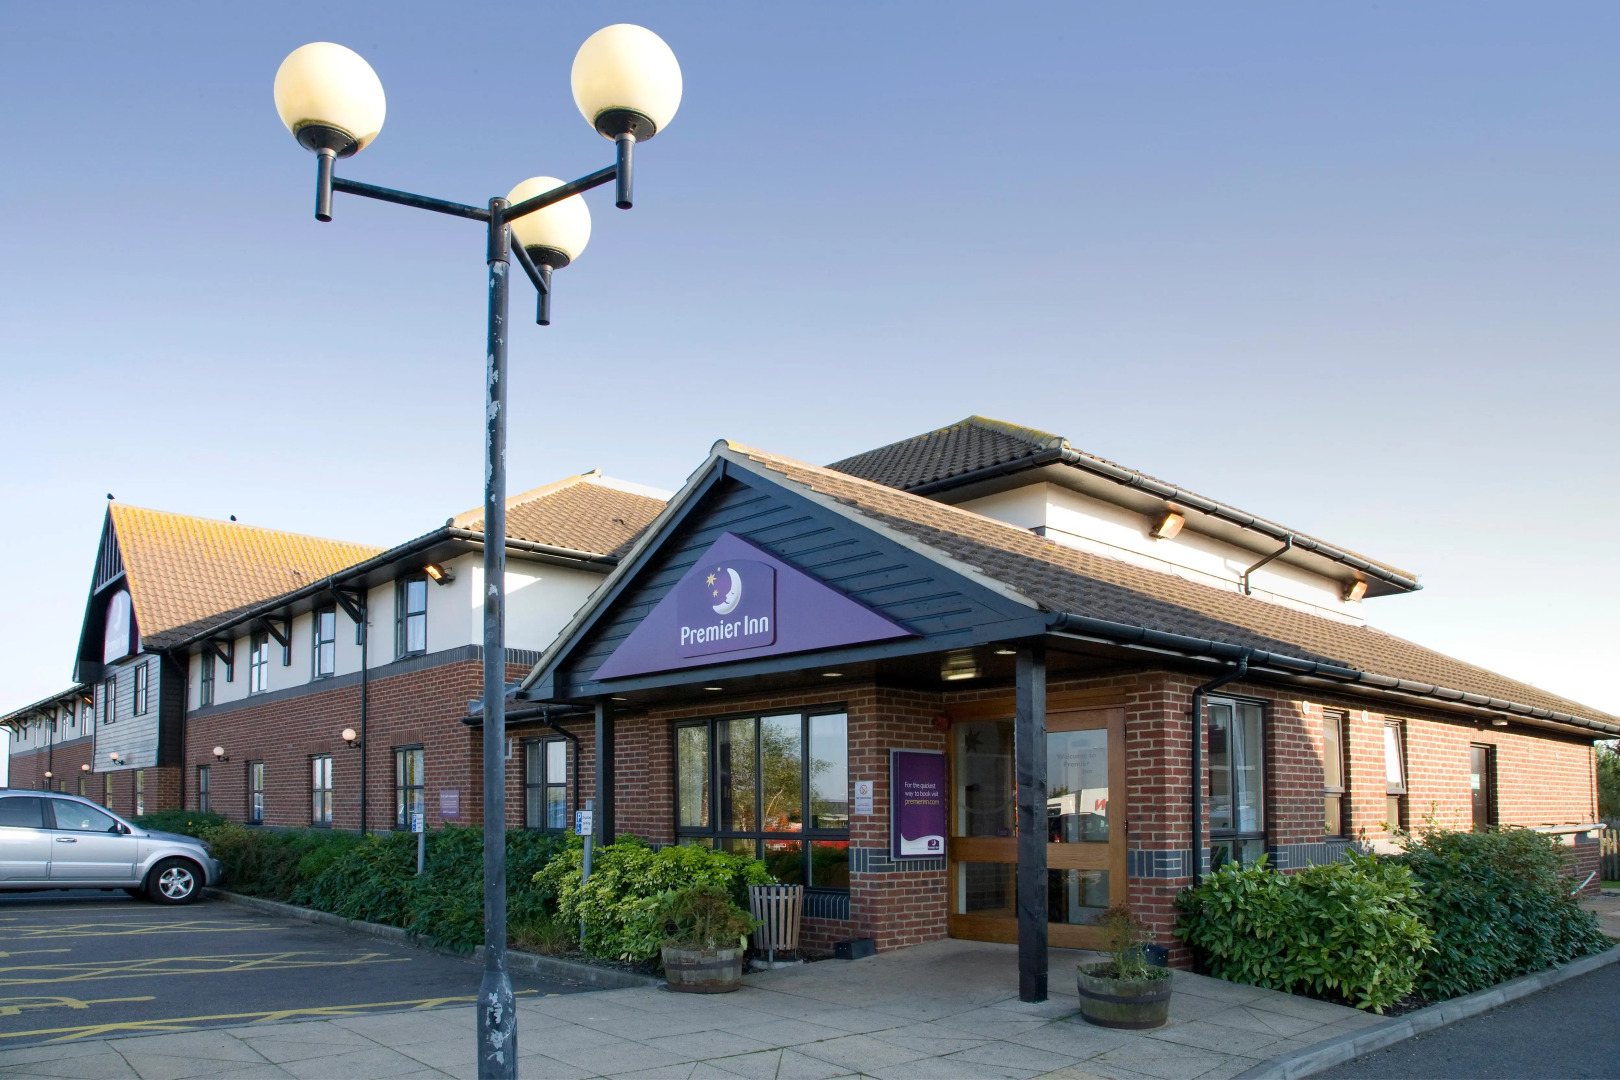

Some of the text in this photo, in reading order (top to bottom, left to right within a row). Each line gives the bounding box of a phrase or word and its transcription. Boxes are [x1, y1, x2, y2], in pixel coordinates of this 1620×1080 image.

[680, 615, 769, 646] Premier Inn
[920, 782, 936, 790] quickest
